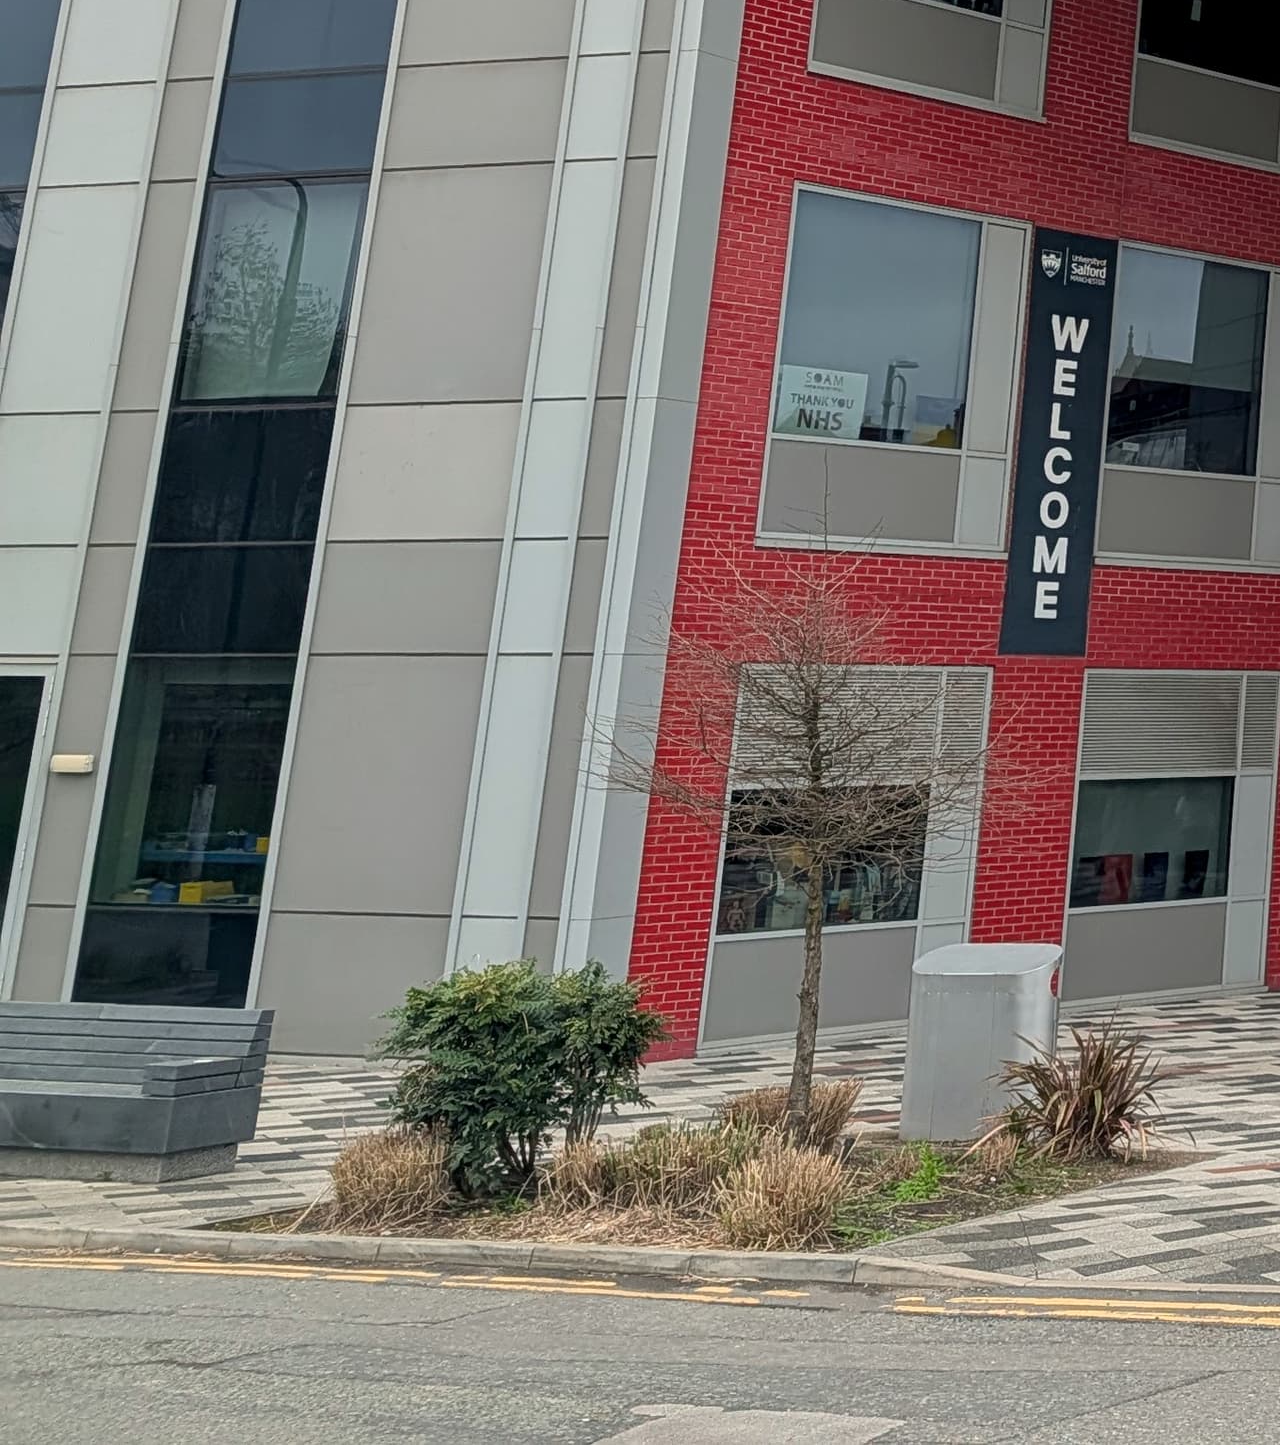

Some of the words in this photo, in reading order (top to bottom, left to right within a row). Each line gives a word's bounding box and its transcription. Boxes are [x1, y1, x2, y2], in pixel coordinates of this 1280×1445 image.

[1071, 263, 1107, 279] Salford
[791, 393, 829, 407] THANK
[831, 397, 855, 410] YOU
[797, 408, 843, 431] NHS
[1032, 314, 1090, 619] WELCOME
